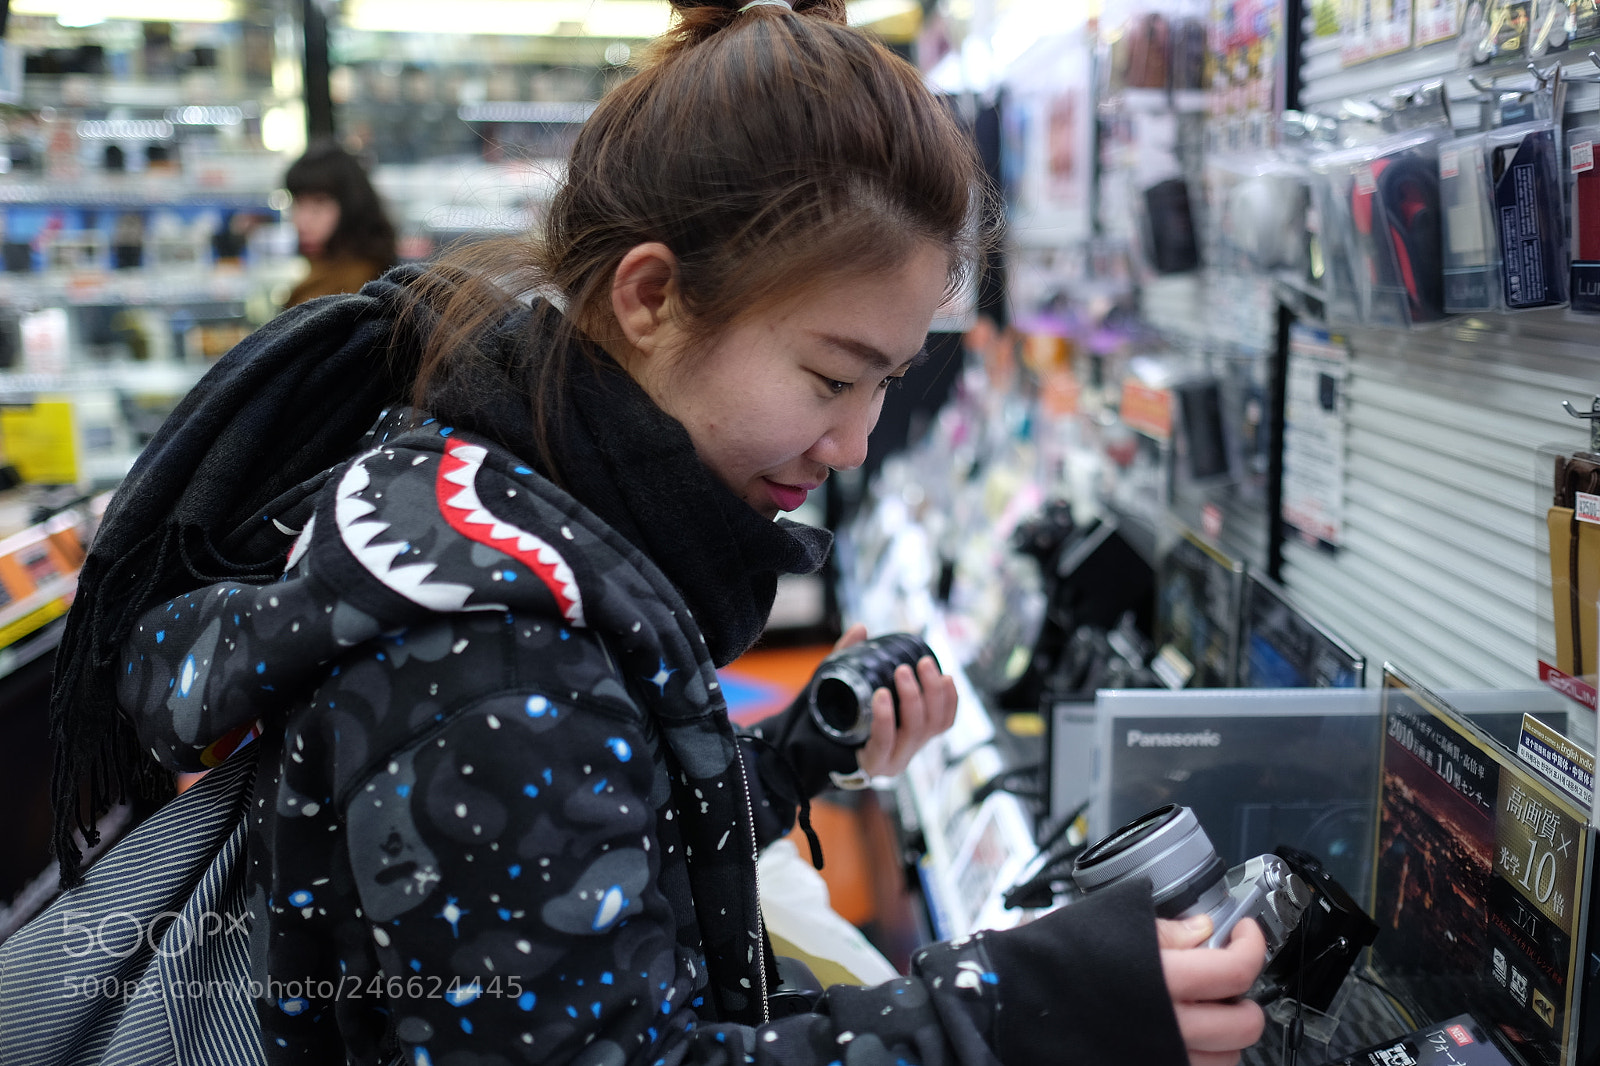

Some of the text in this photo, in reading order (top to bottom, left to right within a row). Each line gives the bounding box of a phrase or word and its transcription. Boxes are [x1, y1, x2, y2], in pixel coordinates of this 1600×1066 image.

[1127, 730, 1222, 747] Panasonic
[1560, 742, 1579, 761] English
[1534, 999, 1552, 1024] 4K
[1449, 1027, 1469, 1044] NEW
